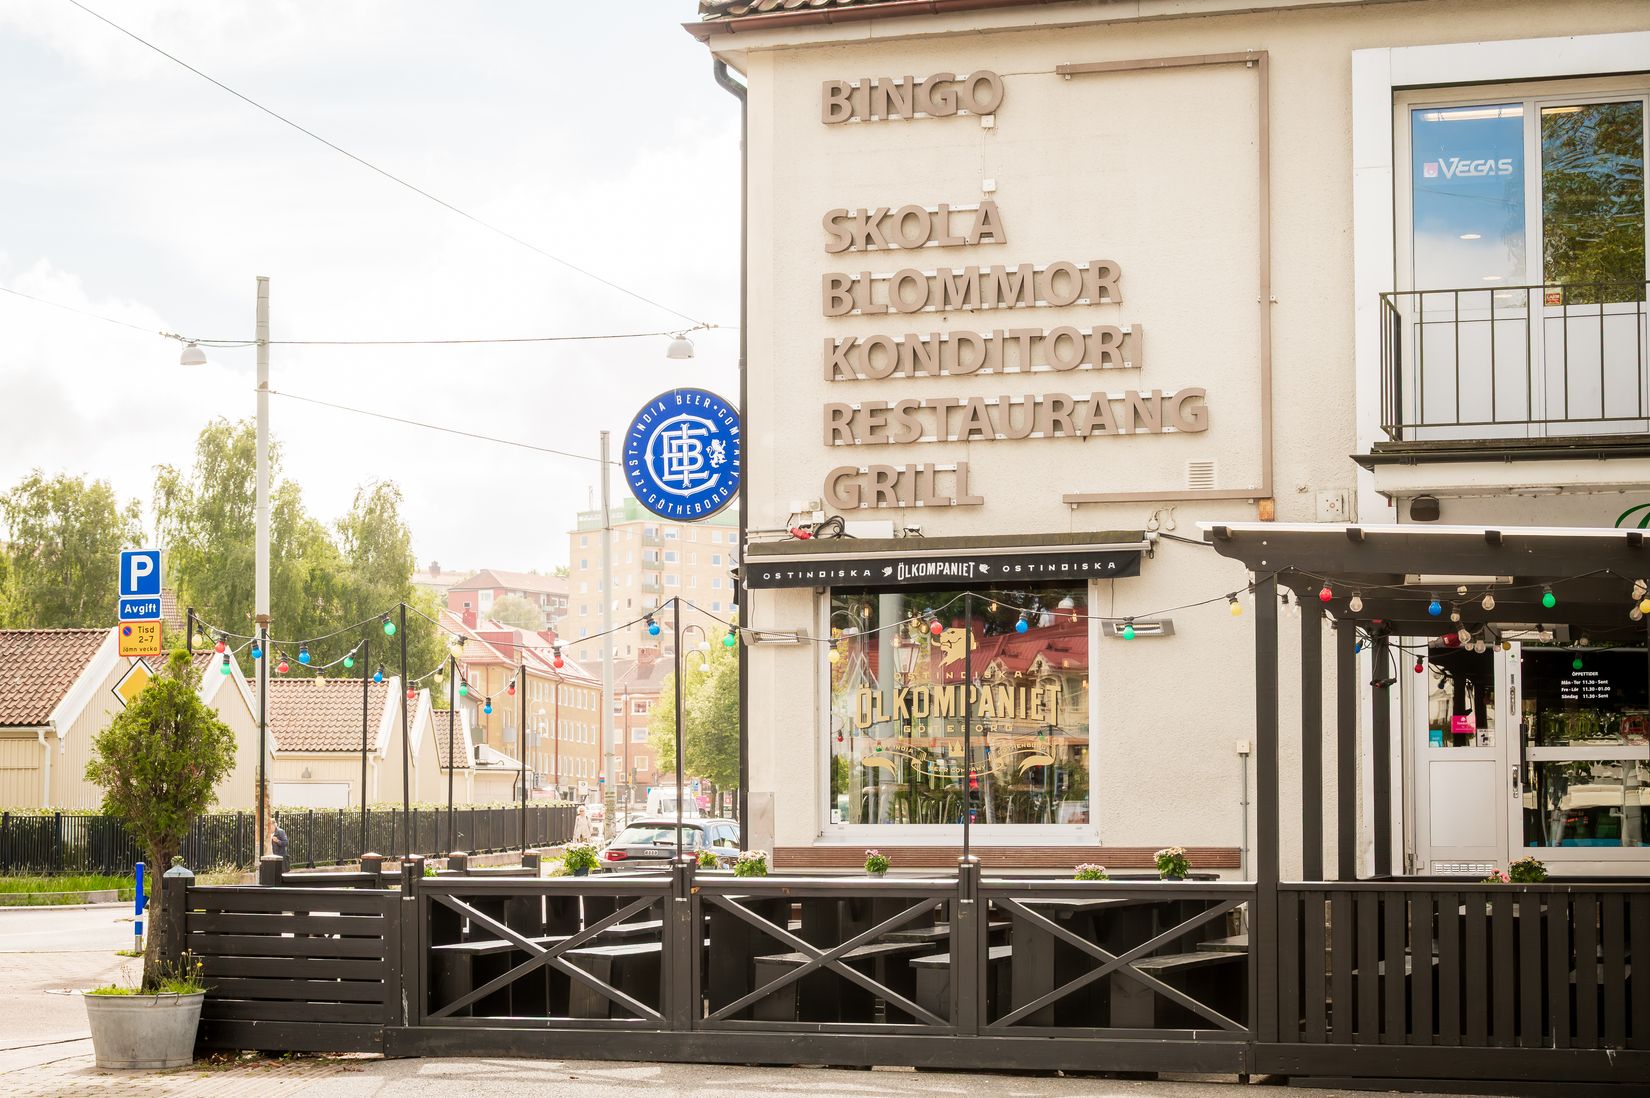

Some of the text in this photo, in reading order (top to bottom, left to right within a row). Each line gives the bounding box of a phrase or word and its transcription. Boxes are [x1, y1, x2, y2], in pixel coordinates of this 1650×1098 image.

[821, 70, 1005, 124] BINGO
[821, 200, 1007, 253] SKOLA
[822, 259, 1123, 317] BLOMMOR
[823, 323, 1143, 382] KONDITORI
[633, 401, 667, 438] INDIA
[676, 394, 711, 409] BEER
[823, 387, 1209, 446] RESTAURANG
[628, 449, 642, 487] EAST
[823, 461, 984, 510] GRILL
[647, 486, 729, 515] GÖTHEBORG
[130, 555, 154, 592] P
[763, 561, 1116, 581] OSTINDISKA ÖLKOMPANIET OSTINDISKA
[124, 603, 157, 615] Avgift
[137, 626, 155, 634] Tisd
[138, 635, 154, 644] 2-7
[893, 670, 1024, 680] OSTINDISKA
[856, 684, 1062, 729] ÖLKOMPANIET
